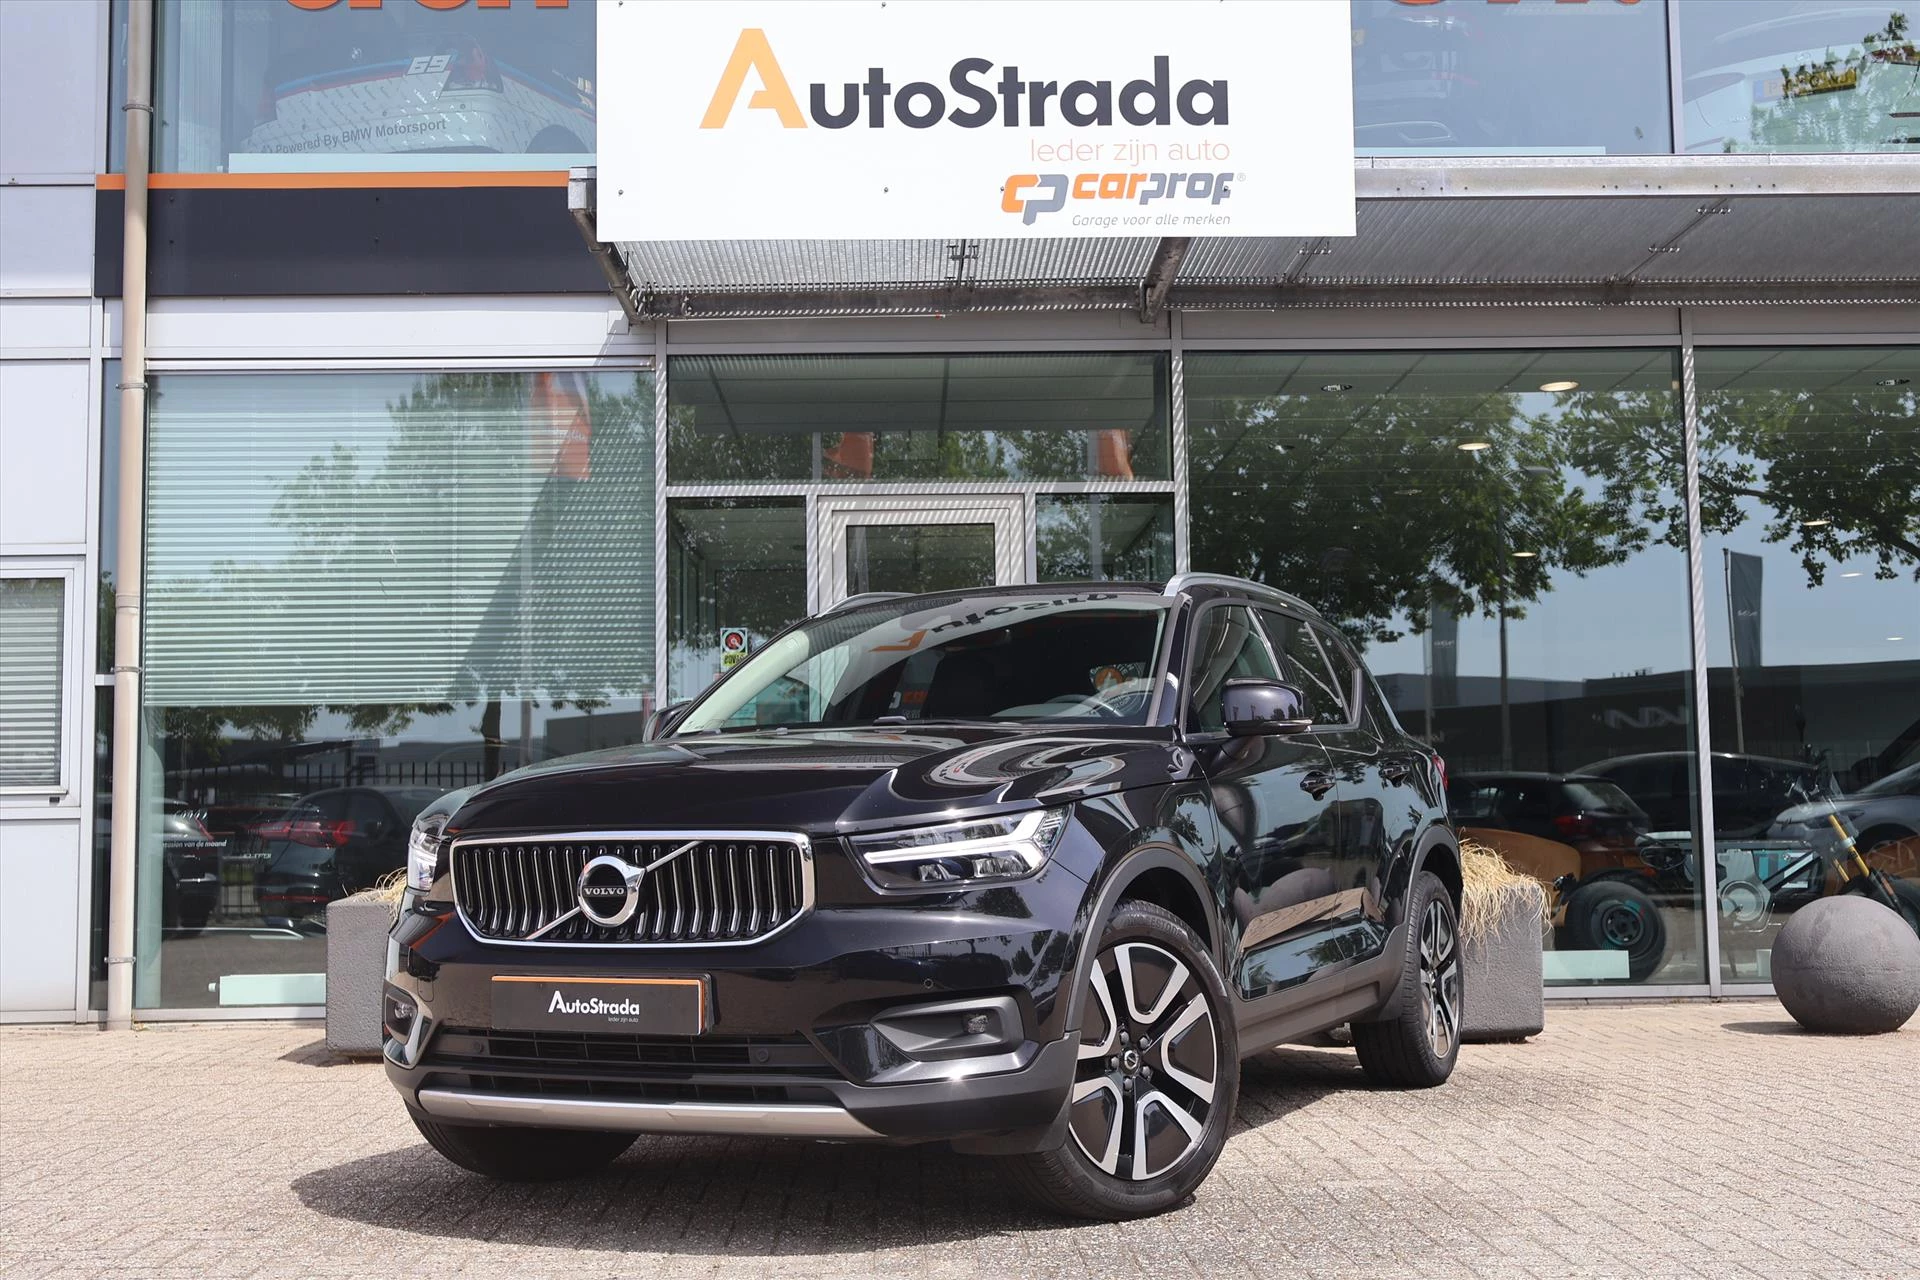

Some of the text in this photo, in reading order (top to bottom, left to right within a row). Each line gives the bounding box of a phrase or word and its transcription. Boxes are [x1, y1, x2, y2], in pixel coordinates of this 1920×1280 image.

[407, 54, 452, 75] 69
[699, 28, 1229, 129] AutoStrada
[275, 135, 321, 153] Powered
[323, 132, 339, 147] By
[342, 127, 372, 143] BMW
[375, 118, 447, 137] Motorsport
[1113, 139, 1158, 167] zijn
[1168, 139, 1231, 161] auto
[1072, 172, 1234, 206] carprof
[1072, 213, 1231, 229] Garage voor alle merken
[584, 887, 625, 895] VOLVO
[548, 990, 640, 1015] AutoStrada
